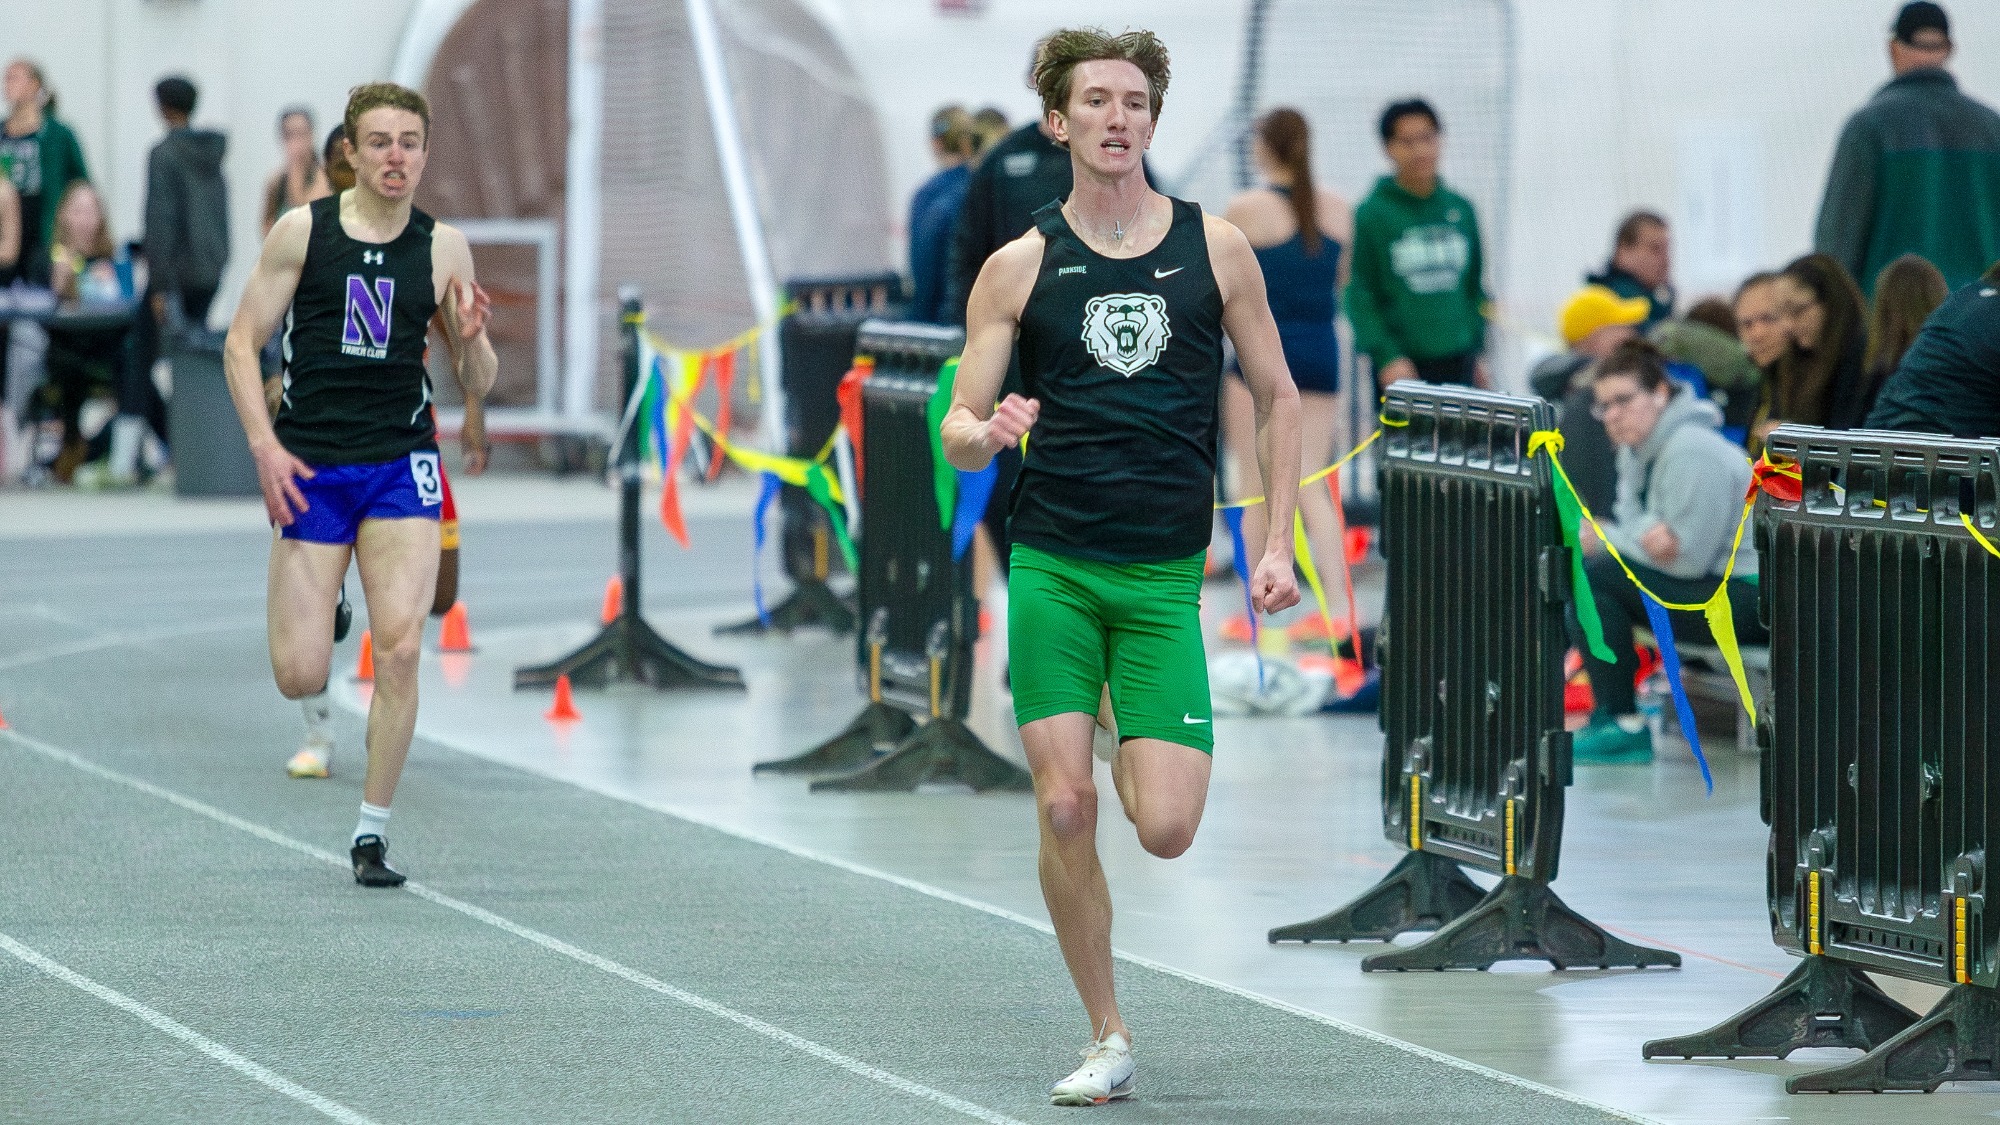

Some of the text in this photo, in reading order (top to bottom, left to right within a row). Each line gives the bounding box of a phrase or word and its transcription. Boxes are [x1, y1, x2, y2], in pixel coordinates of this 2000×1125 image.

[1058, 265, 1087, 277] PARKSIDE
[342, 273, 395, 348] N
[416, 459, 438, 494] 3
